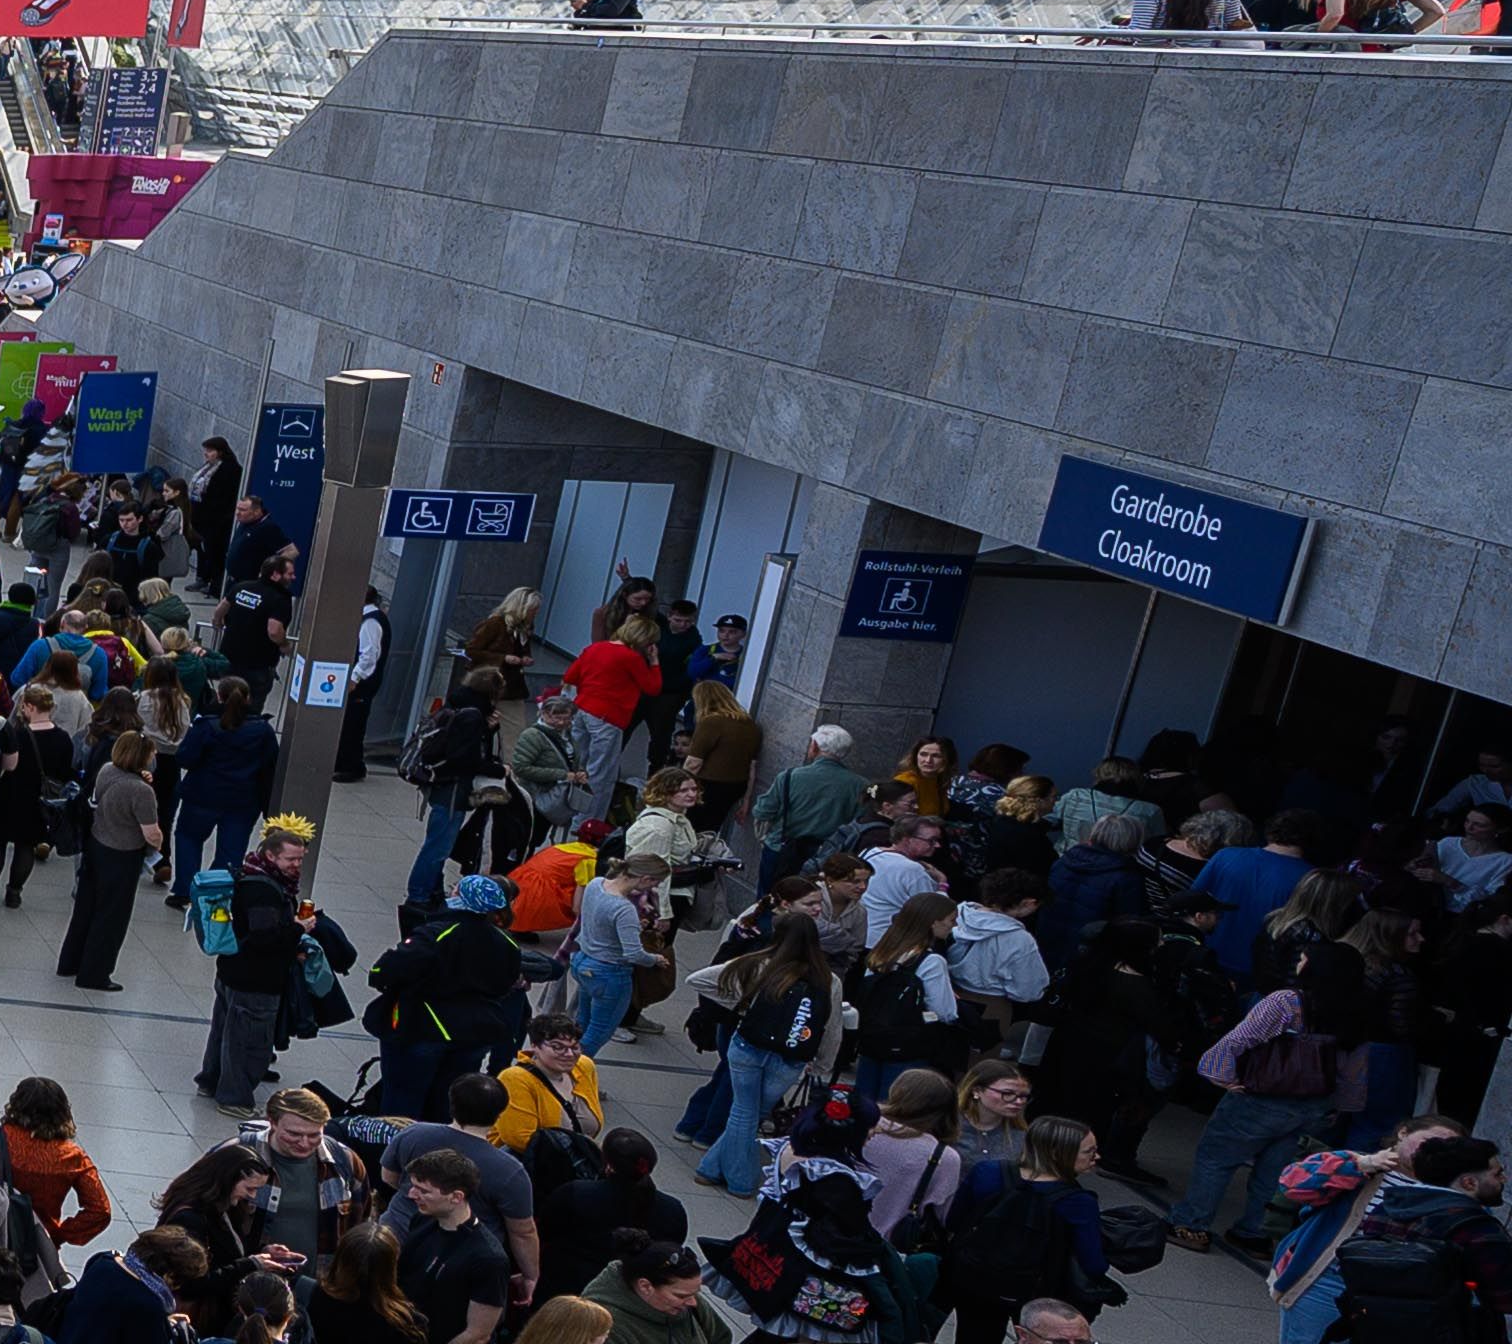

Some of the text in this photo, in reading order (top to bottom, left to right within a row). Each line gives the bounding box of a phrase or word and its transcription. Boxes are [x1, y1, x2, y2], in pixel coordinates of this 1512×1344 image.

[138, 83, 157, 95] 2,4
[89, 407, 144, 420] Was ist
[88, 419, 136, 432] wahr?
[276, 444, 315, 460] West
[273, 458, 280, 473] 1
[1109, 484, 1223, 541] Garderobe
[1097, 528, 1213, 589] Cloakroom
[864, 560, 963, 576] Rollstuhl-Verleih
[857, 617, 937, 633] Ausgabe hier.
[785, 996, 812, 1048] ellesse
